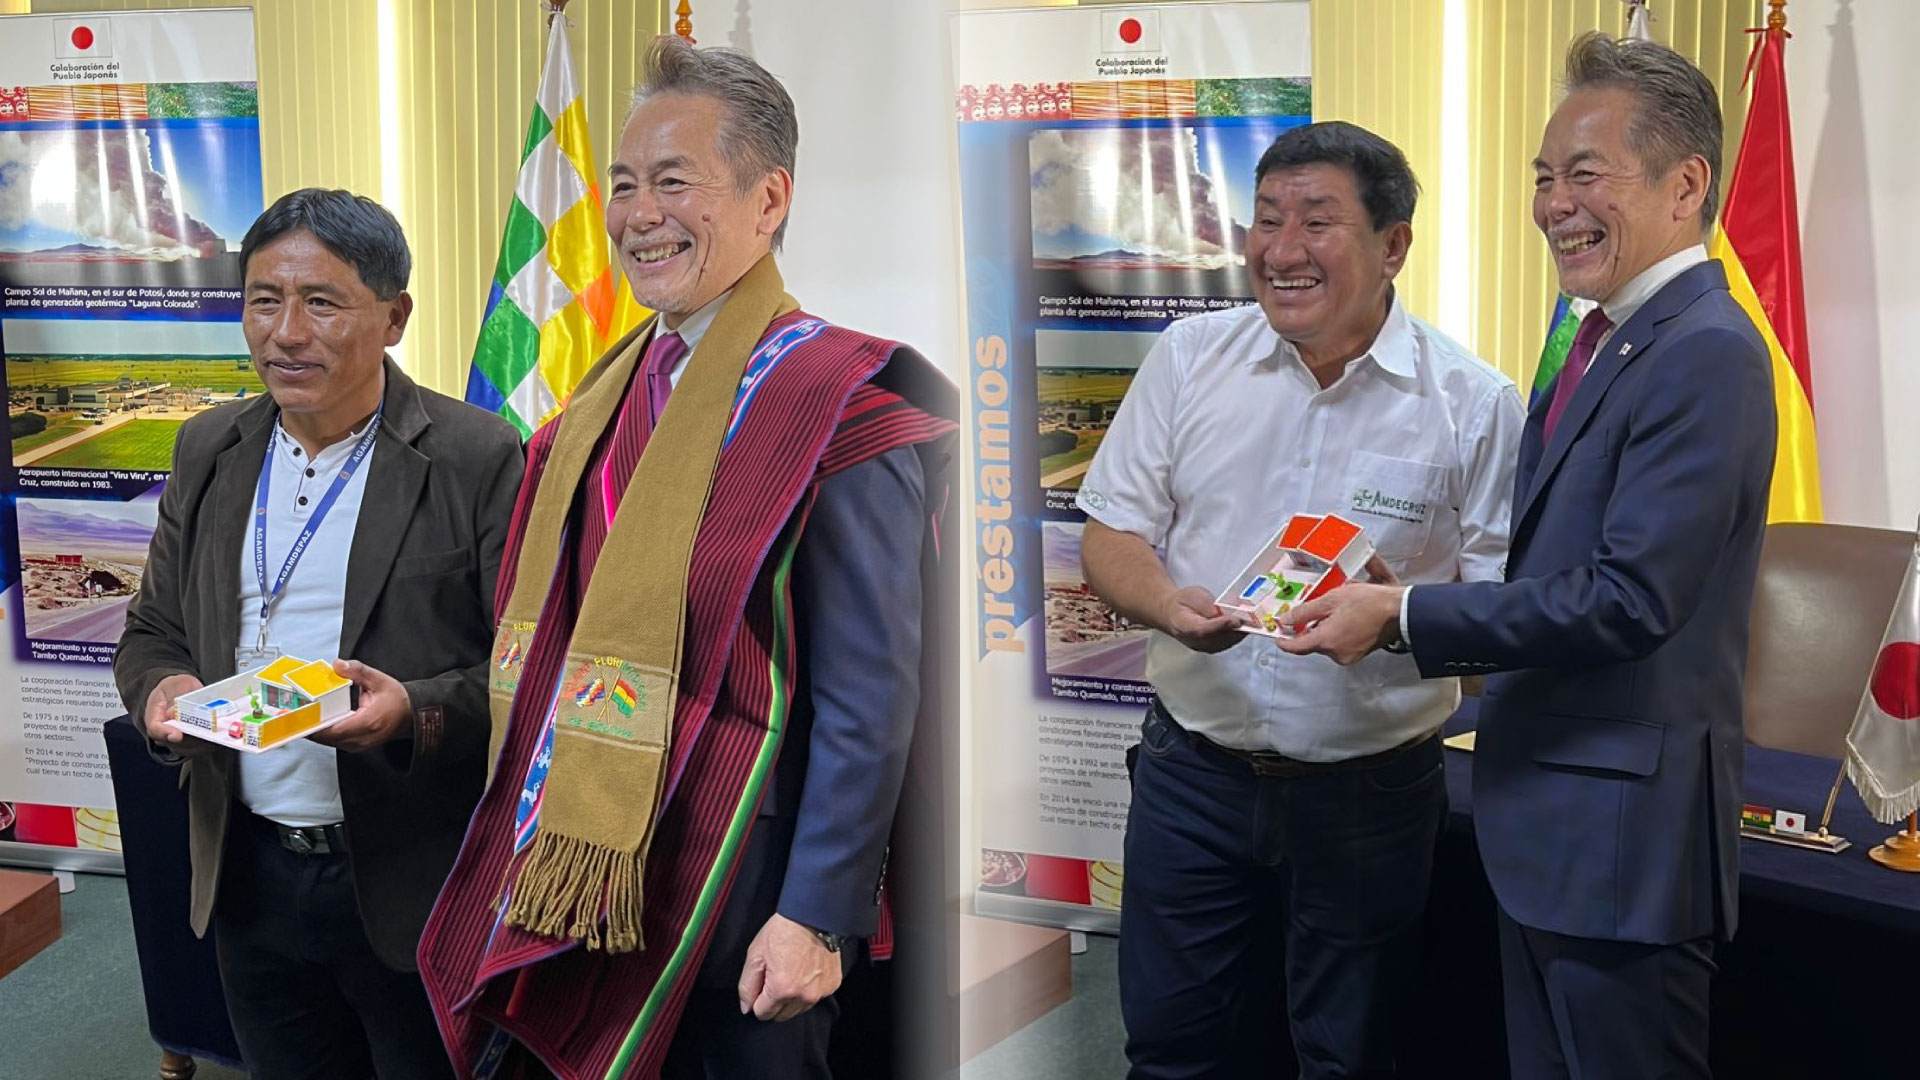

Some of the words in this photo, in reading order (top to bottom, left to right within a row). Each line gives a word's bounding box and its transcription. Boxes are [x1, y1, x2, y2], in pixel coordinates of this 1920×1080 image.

[1096, 58, 1152, 66] Colaboración
[1154, 56, 1168, 66] del
[50, 62, 104, 72] Colaboración
[106, 62, 120, 70] del
[1098, 67, 1128, 76] Pueblo
[1130, 66, 1166, 76] Japonés
[53, 72, 82, 80] Pueblo
[84, 71, 118, 80] Japonés
[4, 288, 32, 297] Campo
[32, 288, 45, 296] Sol
[46, 288, 57, 296] de
[58, 288, 90, 298] Mañana,
[103, 288, 110, 296] el
[112, 289, 125, 297] sur
[126, 288, 138, 297] de
[139, 288, 166, 298] Potosí,
[166, 289, 190, 298] donde
[190, 290, 200, 298] se
[202, 290, 242, 300] construye
[5, 298, 29, 307] planta
[30, 298, 40, 307] de
[42, 298, 84, 308] generación
[86, 299, 127, 308] geotérmica
[128, 299, 161, 308] "Laguna
[162, 300, 201, 308] Colorada".
[1039, 296, 1067, 306] Campo
[1068, 296, 1082, 305] Sol
[1082, 296, 1094, 305] de
[1142, 298, 1150, 306] el
[1166, 298, 1178, 307] de
[1208, 299, 1232, 308] donde
[1040, 307, 1064, 317] planta
[1066, 307, 1076, 316] de
[1078, 308, 1122, 318] generación
[1122, 308, 1166, 319] geotérmica
[18, 468, 60, 478] Aeropuerto
[62, 470, 108, 479] internacional
[110, 471, 129, 480] "Viru
[130, 472, 152, 482] Viru",
[20, 479, 39, 488] Cruz,
[40, 480, 79, 488] construido
[92, 480, 113, 489] 1983.
[256, 527, 265, 585] AGAMDEPAZ
[279, 530, 312, 584] AGAMDEPAZ
[31, 642, 80, 652] Mejoramiento
[32, 651, 57, 660] Tambo
[58, 652, 96, 663] Quemado,
[30, 676, 73, 686] cooperación
[75, 678, 110, 688] financiera
[21, 686, 64, 695] condiciones
[64, 688, 100, 698] favorables
[102, 691, 118, 699] para
[1104, 683, 1110, 692] y
[1052, 686, 1078, 698] Tambo
[1120, 694, 1134, 702] con
[1136, 696, 1147, 704] un
[22, 696, 64, 706] estratégicos
[66, 699, 104, 708] requeridos
[35, 712, 52, 720] 1975
[62, 714, 78, 722] 1992
[24, 722, 58, 731] proyectos
[60, 724, 68, 732] de
[24, 732, 42, 740] otros
[44, 733, 76, 742] sectores.
[36, 748, 54, 756] 2014
[25, 757, 59, 767] "Proyecto
[42, 768, 60, 776] tiene
[72, 770, 93, 778] techo
